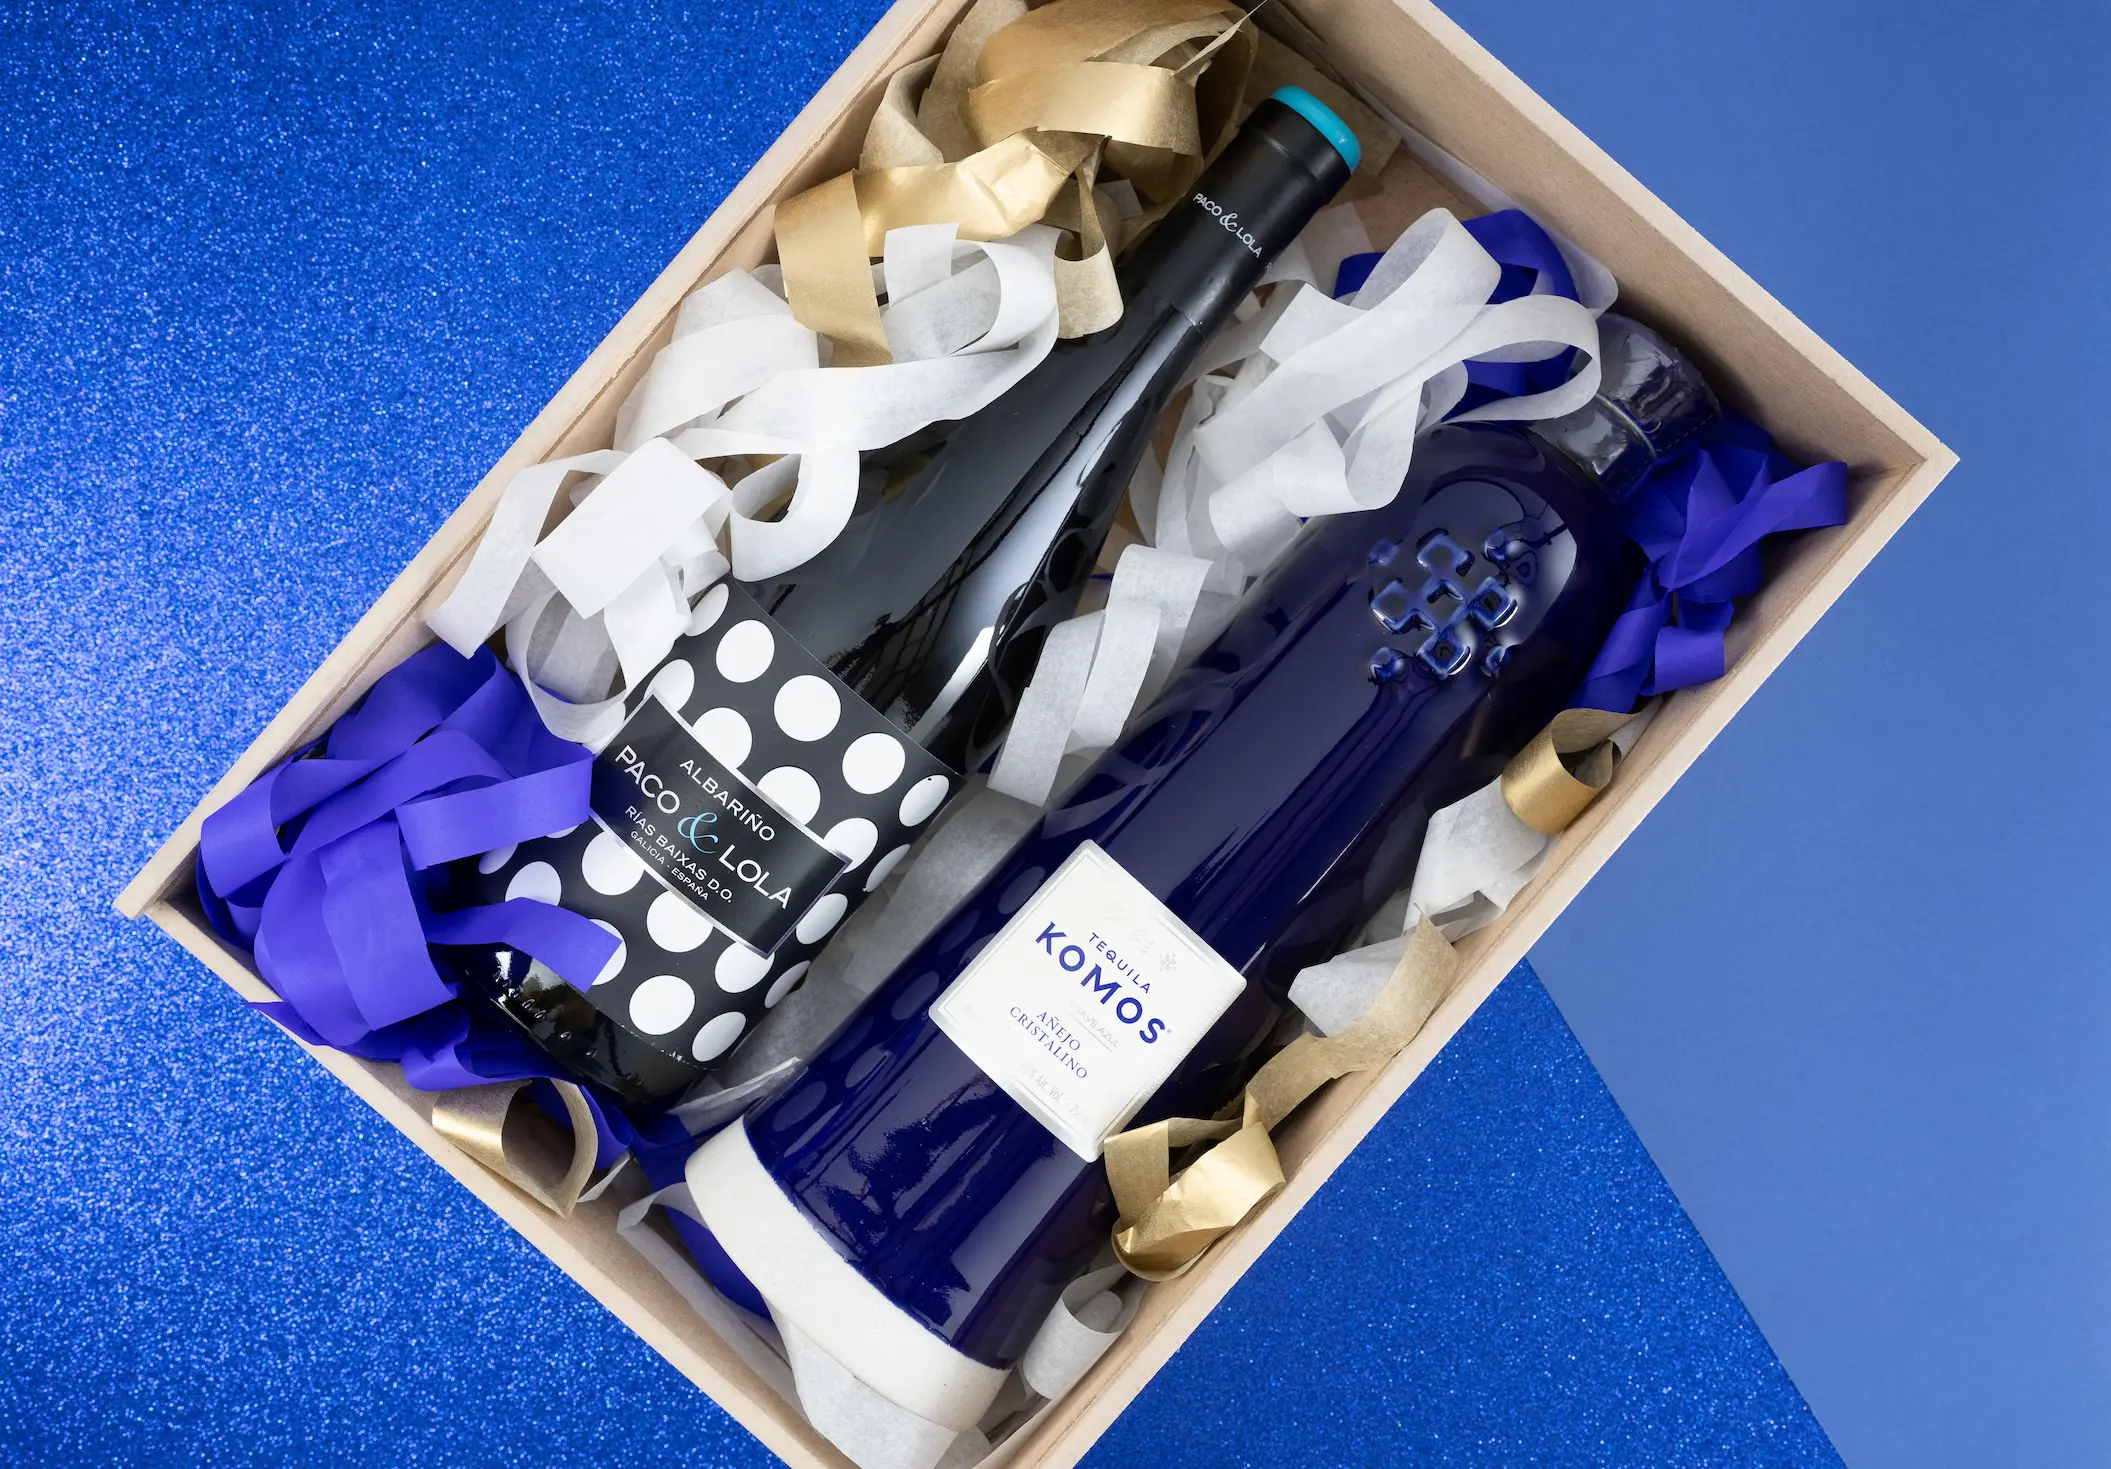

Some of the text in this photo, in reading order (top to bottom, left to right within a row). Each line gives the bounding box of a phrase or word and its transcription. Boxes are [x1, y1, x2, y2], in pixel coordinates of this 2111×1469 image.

[1193, 193, 1262, 258] PACO & LOLA
[615, 745, 792, 909] PACO & LOLA
[679, 760, 775, 841] ALBARIÑO
[626, 806, 732, 903] RÍAS BAIXAS D.O.
[631, 831, 665, 864] GALICIA
[671, 867, 708, 900] ESPAÑA
[1036, 921, 1165, 1043] KOMOS
[1090, 933, 1150, 993] TEQUILA
[1011, 1007, 1087, 1078] CRISTALINO
[1037, 1012, 1080, 1050] AÑEJO
